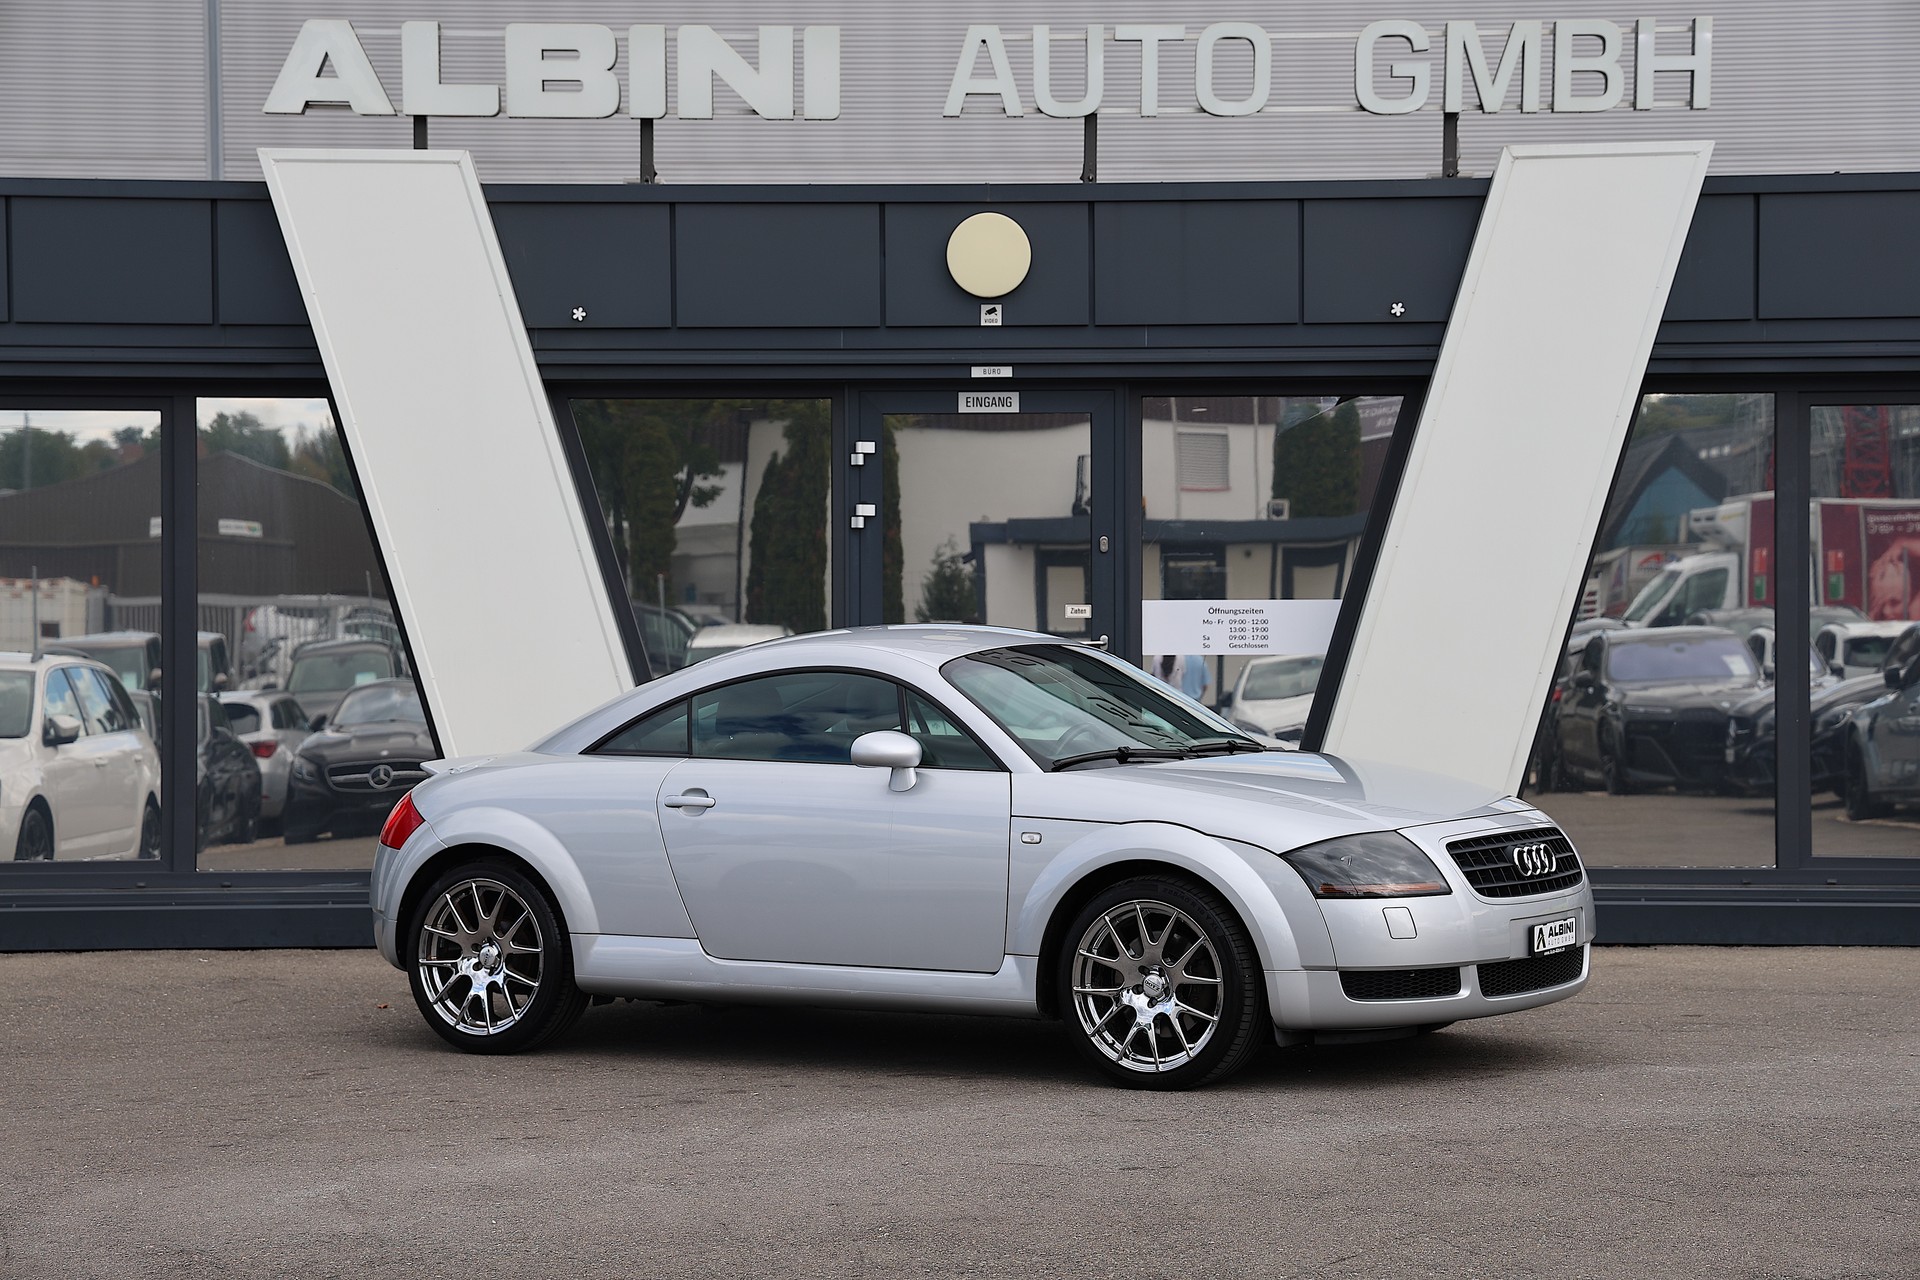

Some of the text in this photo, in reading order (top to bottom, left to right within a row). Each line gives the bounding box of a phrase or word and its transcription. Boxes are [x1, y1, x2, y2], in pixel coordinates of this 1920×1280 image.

[263, 16, 1713, 120] ALBINI AUTO GMBH
[982, 367, 1001, 375] BÜRO
[965, 396, 1012, 408] EINGANG
[1208, 607, 1264, 615] Öffnungszeiten
[1548, 921, 1573, 938] ALBINI
